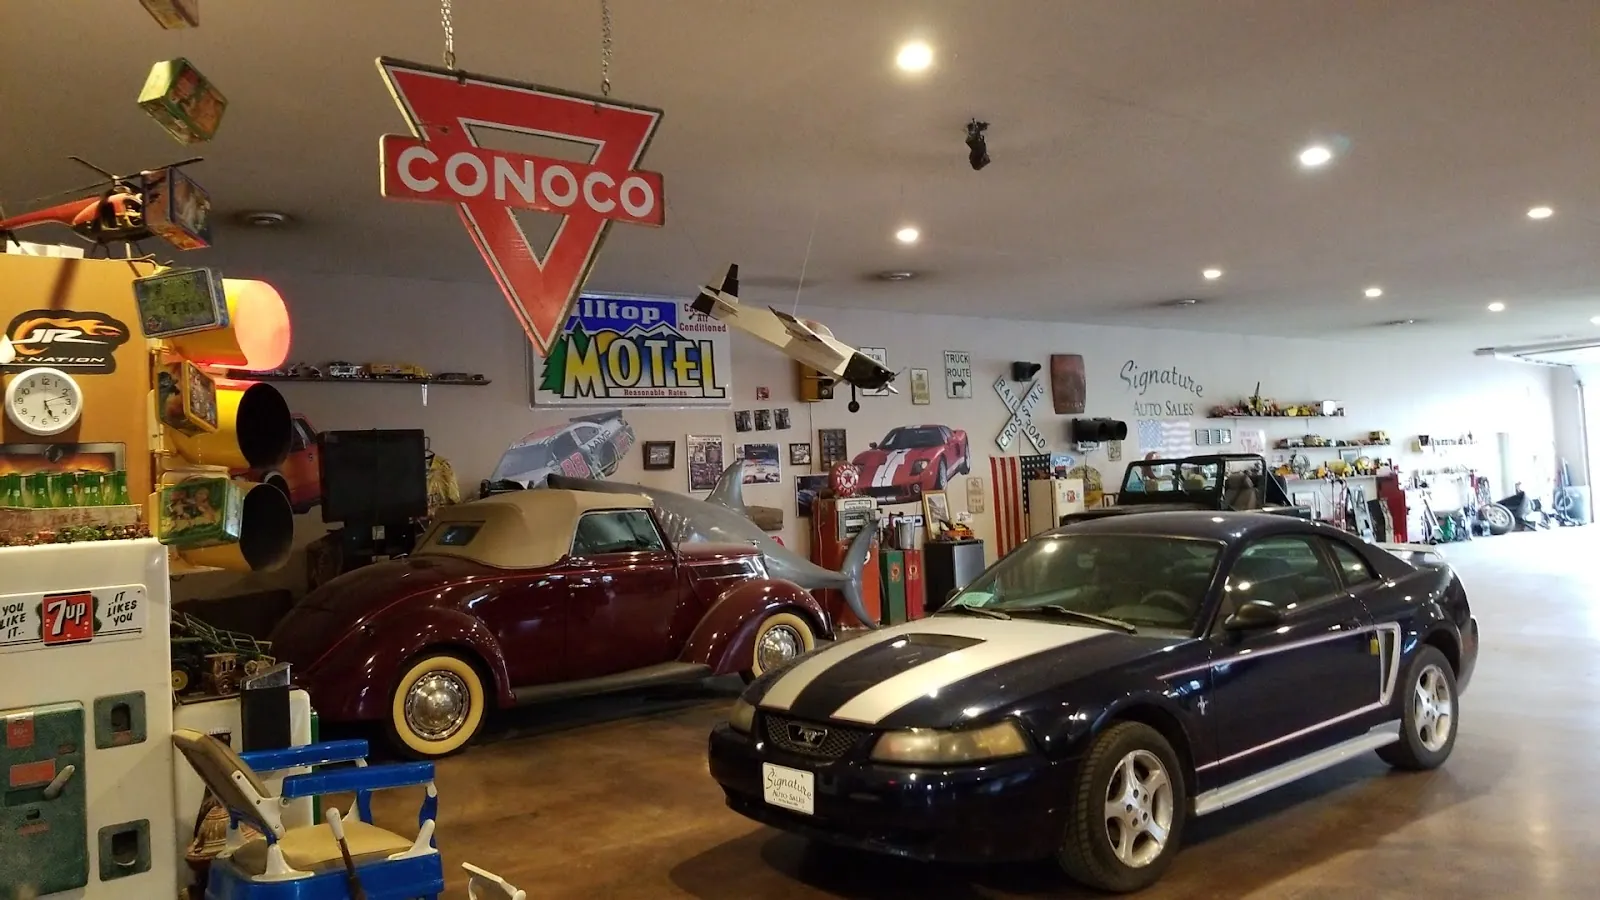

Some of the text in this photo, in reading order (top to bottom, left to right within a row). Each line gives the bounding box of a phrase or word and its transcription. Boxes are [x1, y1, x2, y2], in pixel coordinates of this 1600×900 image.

[396, 145, 655, 218] CONOCO
[679, 322, 727, 333] Conditioned
[945, 353, 969, 363] TRUCK
[560, 335, 726, 398] MOTEL
[946, 368, 971, 378] ROUTE
[41, 377, 51, 386] 12
[1120, 359, 1204, 398] Signature
[54, 380, 58, 388] 1
[21, 387, 30, 396] 10
[62, 388, 68, 396] 2
[17, 397, 24, 405] 9
[65, 398, 72, 406] 3
[21, 407, 28, 415] 8
[1165, 400, 1195, 416] SALES
[41, 418, 48, 426] 6
[53, 415, 60, 423] 5
[1110, 447, 1121, 459] 25
[2, 602, 25, 617] YOU
[107, 599, 138, 618] LIKES
[0, 612, 27, 630] LIKE
[113, 612, 133, 627] YOU
[765, 767, 812, 801] Signature
